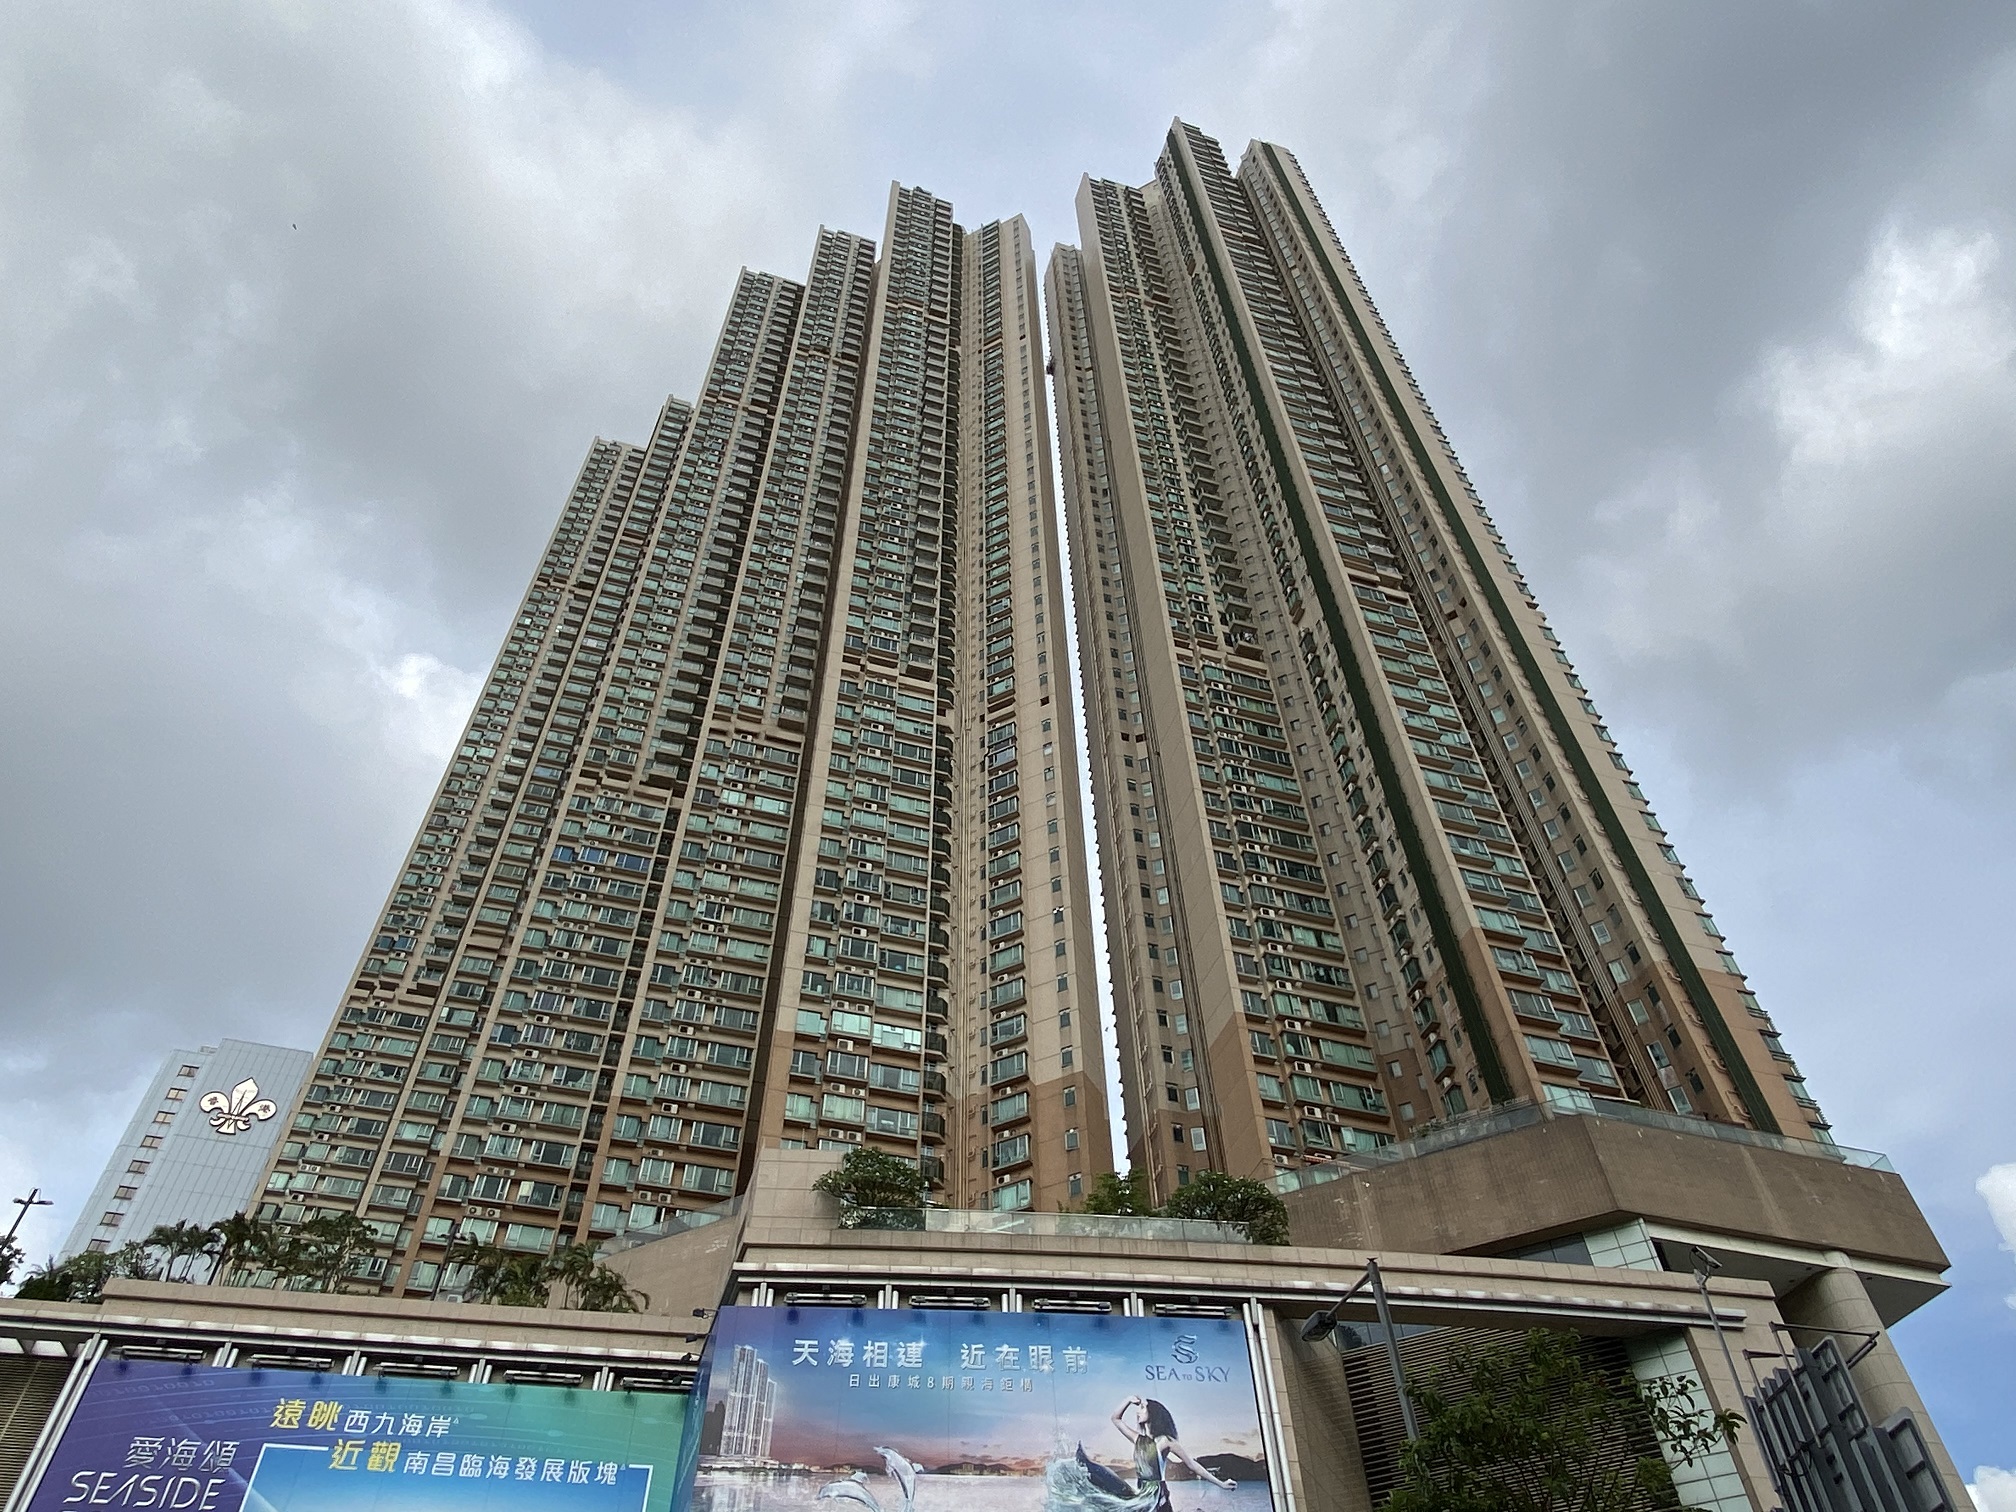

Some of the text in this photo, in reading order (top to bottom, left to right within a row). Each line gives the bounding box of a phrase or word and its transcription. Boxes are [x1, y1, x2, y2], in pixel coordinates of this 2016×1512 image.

[792, 1339, 1088, 1373] 天海相連 近在眼前
[1145, 1364, 1180, 1381] SEA
[1195, 1366, 1231, 1382] SKY
[122, 1436, 240, 1474] 愛海頌
[62, 1471, 226, 1511] SEASIDE
